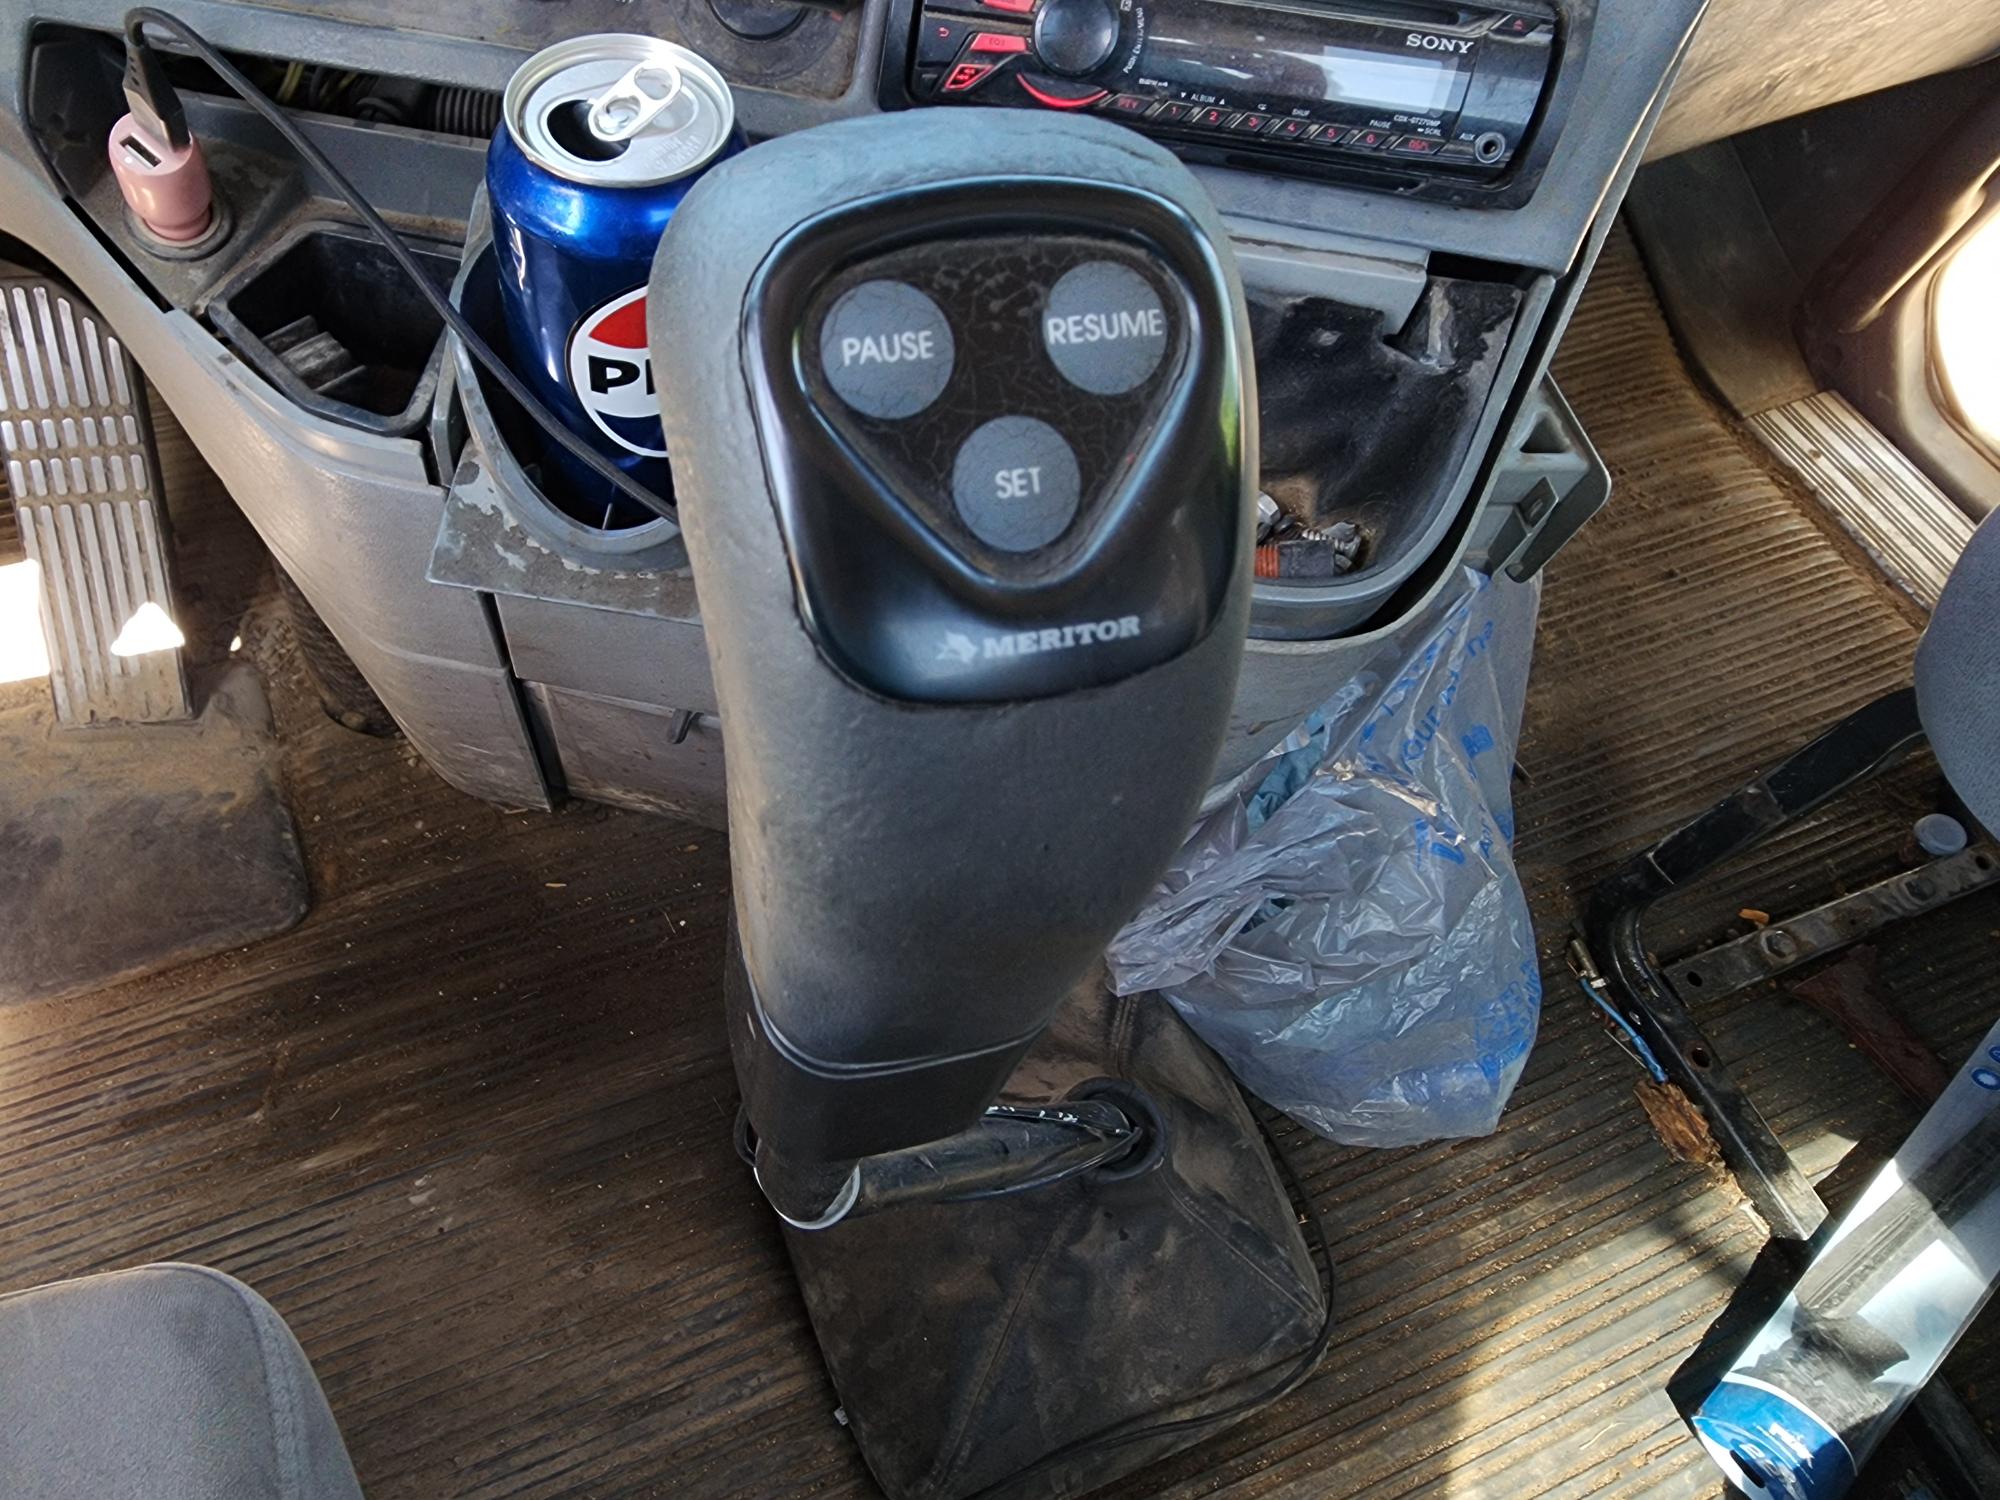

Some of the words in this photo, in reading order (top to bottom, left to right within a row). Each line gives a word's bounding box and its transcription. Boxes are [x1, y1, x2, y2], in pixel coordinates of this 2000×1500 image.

[1406, 33, 1474, 54] SONY
[1190, 93, 1216, 103] ALBUM
[1209, 111, 1217, 121] 2
[1248, 117, 1258, 127] 3
[1287, 122, 1296, 132] 4
[1327, 128, 1336, 138] 5
[1366, 134, 1376, 144] 6
[1369, 119, 1392, 129] PAUSE
[1047, 308, 1164, 346] RESUME
[841, 330, 935, 367] PAUSE
[995, 466, 1042, 500] SET
[983, 615, 1142, 660] MERITOR
